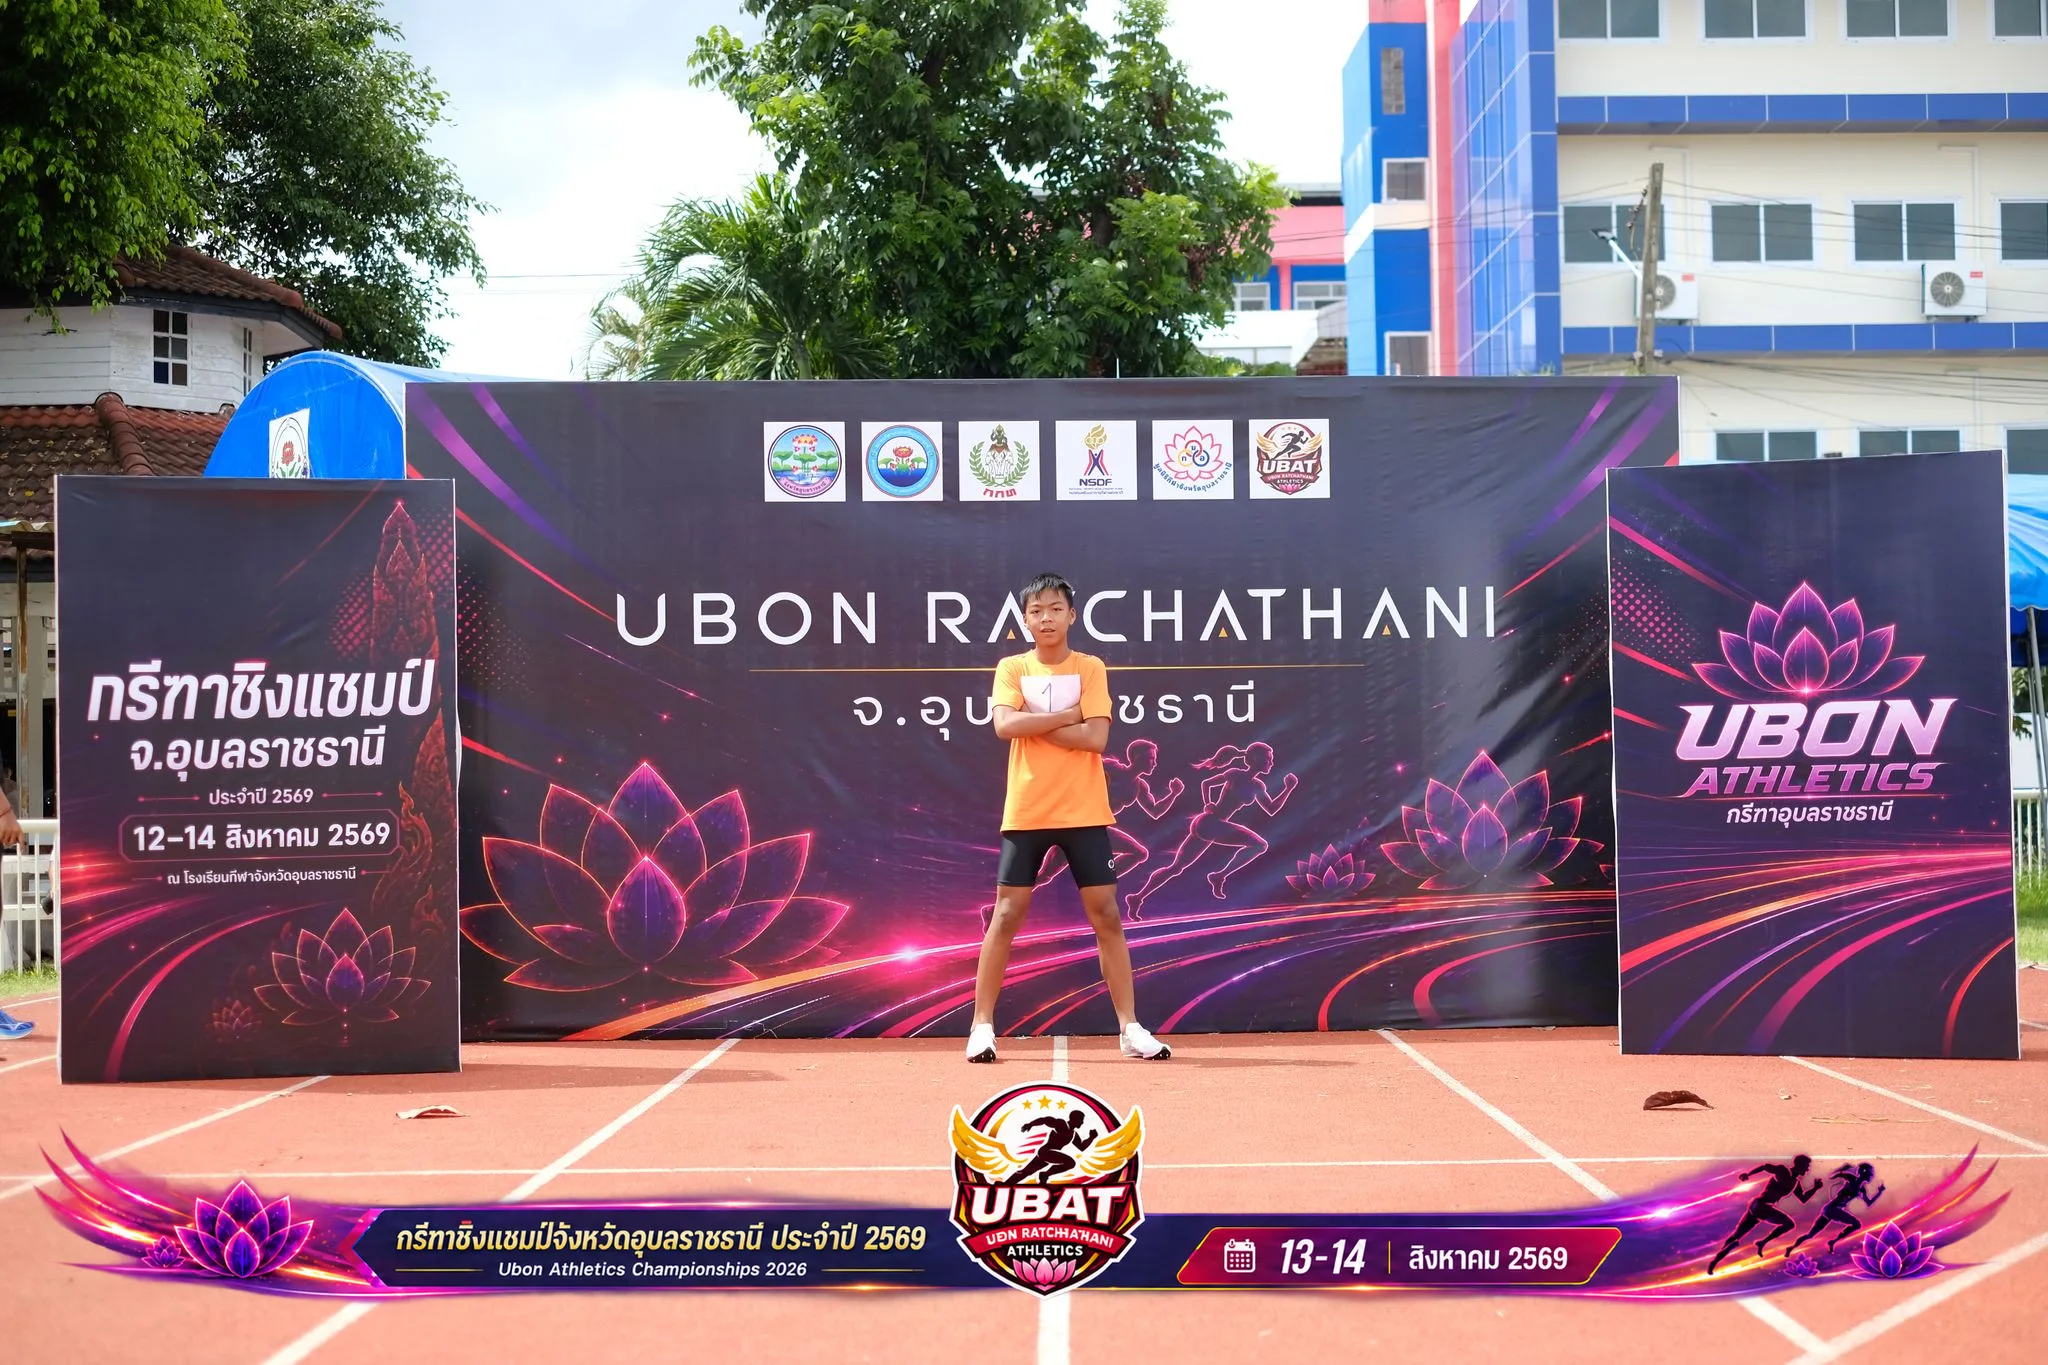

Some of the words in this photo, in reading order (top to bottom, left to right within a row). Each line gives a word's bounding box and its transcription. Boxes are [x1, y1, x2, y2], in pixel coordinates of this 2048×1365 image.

[1262, 459, 1318, 474] UBAT
[983, 488, 1017, 498] กกท
[1079, 478, 1113, 487] NSDF
[616, 591, 876, 646] UBON
[927, 586, 1495, 644] RACHATHANI
[87, 658, 436, 721] กรีฑาชิงแชมป์
[1041, 682, 1052, 713] 1
[853, 679, 1255, 741] จ.อุบชธานี
[1676, 698, 1958, 761] UBON
[130, 724, 387, 782] จ.อุบลราชธานี
[1682, 762, 1942, 797] ATHLETICS
[208, 787, 267, 805] ประจำปี
[272, 788, 314, 804] 2569
[1726, 800, 1894, 828] กรีฑาอุบลราชธานี
[225, 824, 319, 849] สิงหาคม
[328, 822, 391, 846] 2569
[167, 874, 180, 885] ณ
[183, 866, 357, 885] โรงเรียนกีฬาจังหวัดอุบลราชธานี
